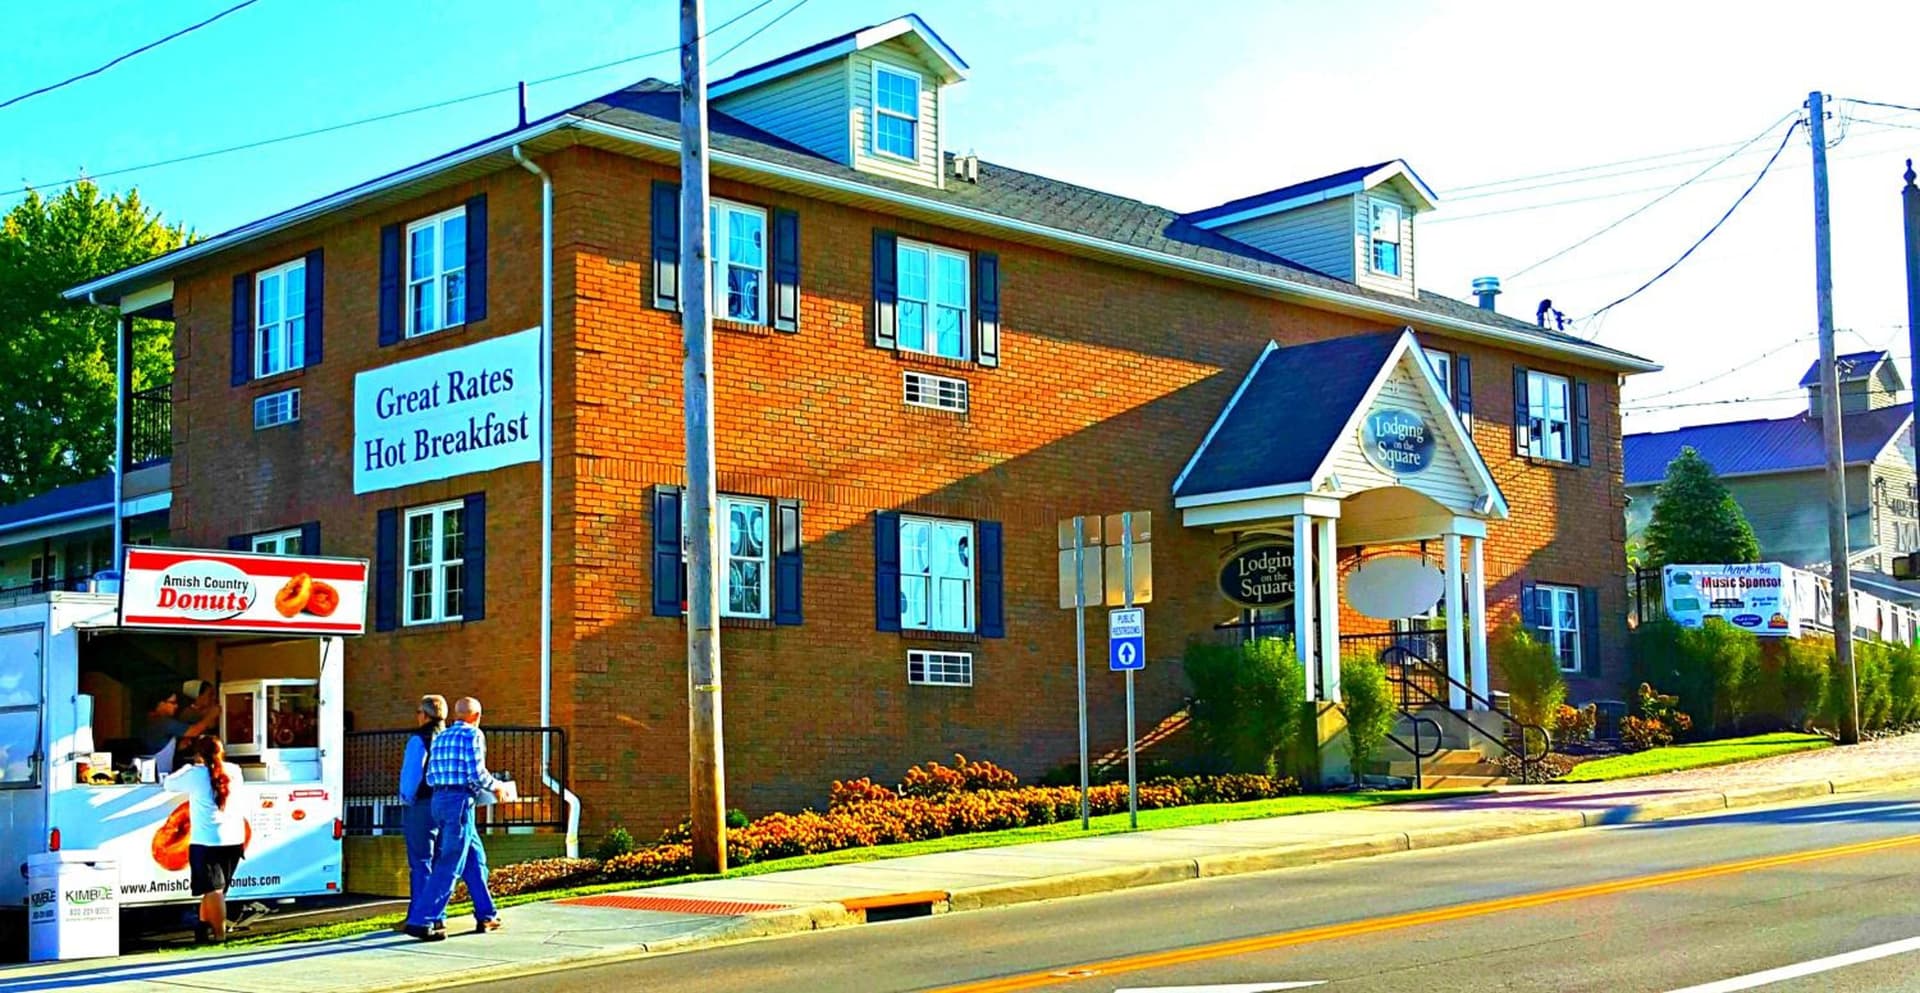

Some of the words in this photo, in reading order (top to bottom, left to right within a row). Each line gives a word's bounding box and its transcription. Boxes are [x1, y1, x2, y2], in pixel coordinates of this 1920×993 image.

[376, 380, 440, 419] Great
[447, 367, 514, 404] Rates
[364, 437, 407, 471] Hot
[414, 411, 529, 461] Breakfast
[1376, 416, 1424, 443] Lodging
[1378, 441, 1420, 469] Square
[1403, 440, 1415, 451] the
[1239, 551, 1293, 576] Lodgin
[1723, 564, 1751, 575] Thank
[1755, 564, 1771, 575] You
[163, 574, 201, 587] Amish
[204, 576, 249, 594] Country
[1260, 574, 1273, 582] on
[1273, 571, 1288, 580] the
[1702, 576, 1737, 589] Music
[157, 588, 249, 611] Donuts
[1240, 579, 1296, 602] Square
[65, 887, 113, 903] KIMBLE
